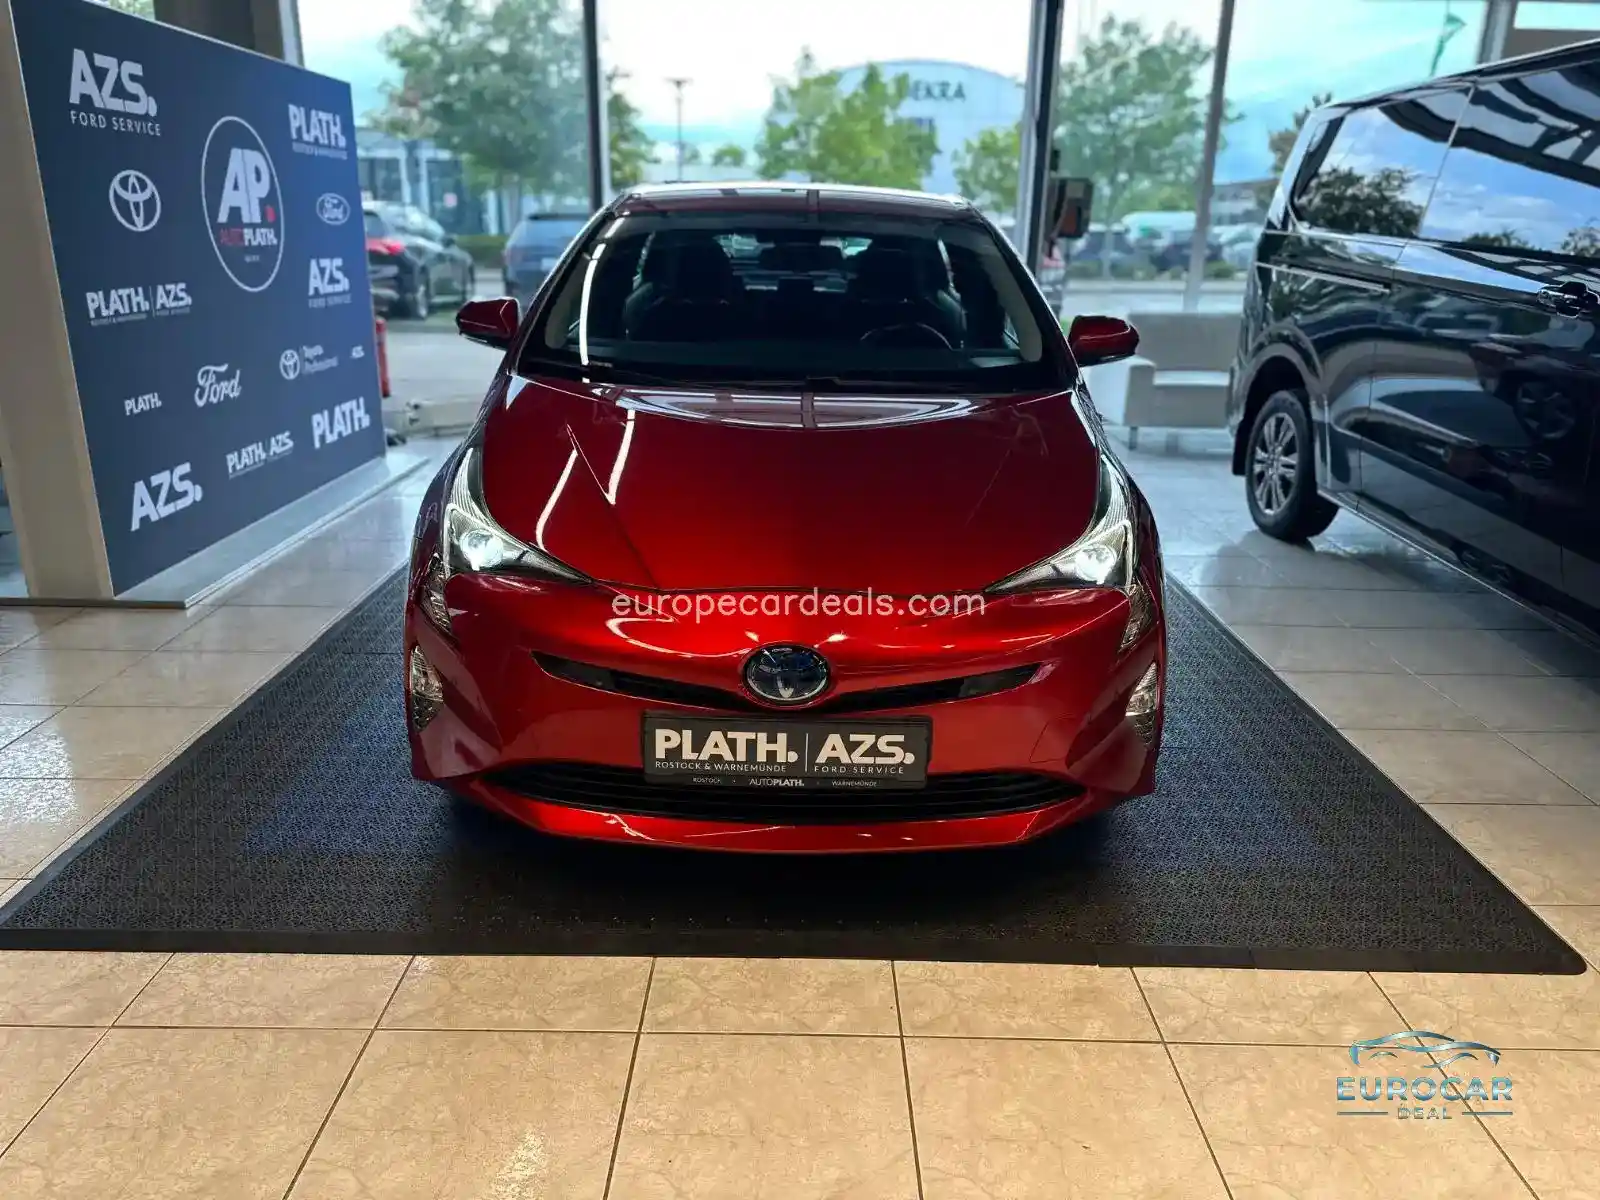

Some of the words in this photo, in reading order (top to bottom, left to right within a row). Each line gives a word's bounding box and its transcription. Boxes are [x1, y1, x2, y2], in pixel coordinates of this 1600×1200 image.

[69, 48, 158, 118] AZS.
[70, 110, 107, 129] FORD
[112, 117, 161, 137] SERVICE
[195, 364, 241, 408] Ford
[131, 463, 203, 532] AZS.
[655, 728, 799, 763] PLATH.
[815, 733, 915, 765] AZS.
[655, 761, 701, 770] ROSTOCK
[714, 763, 787, 773] WARNEMÜNDE
[814, 766, 847, 774] FORD
[853, 766, 904, 774] SERVICE
